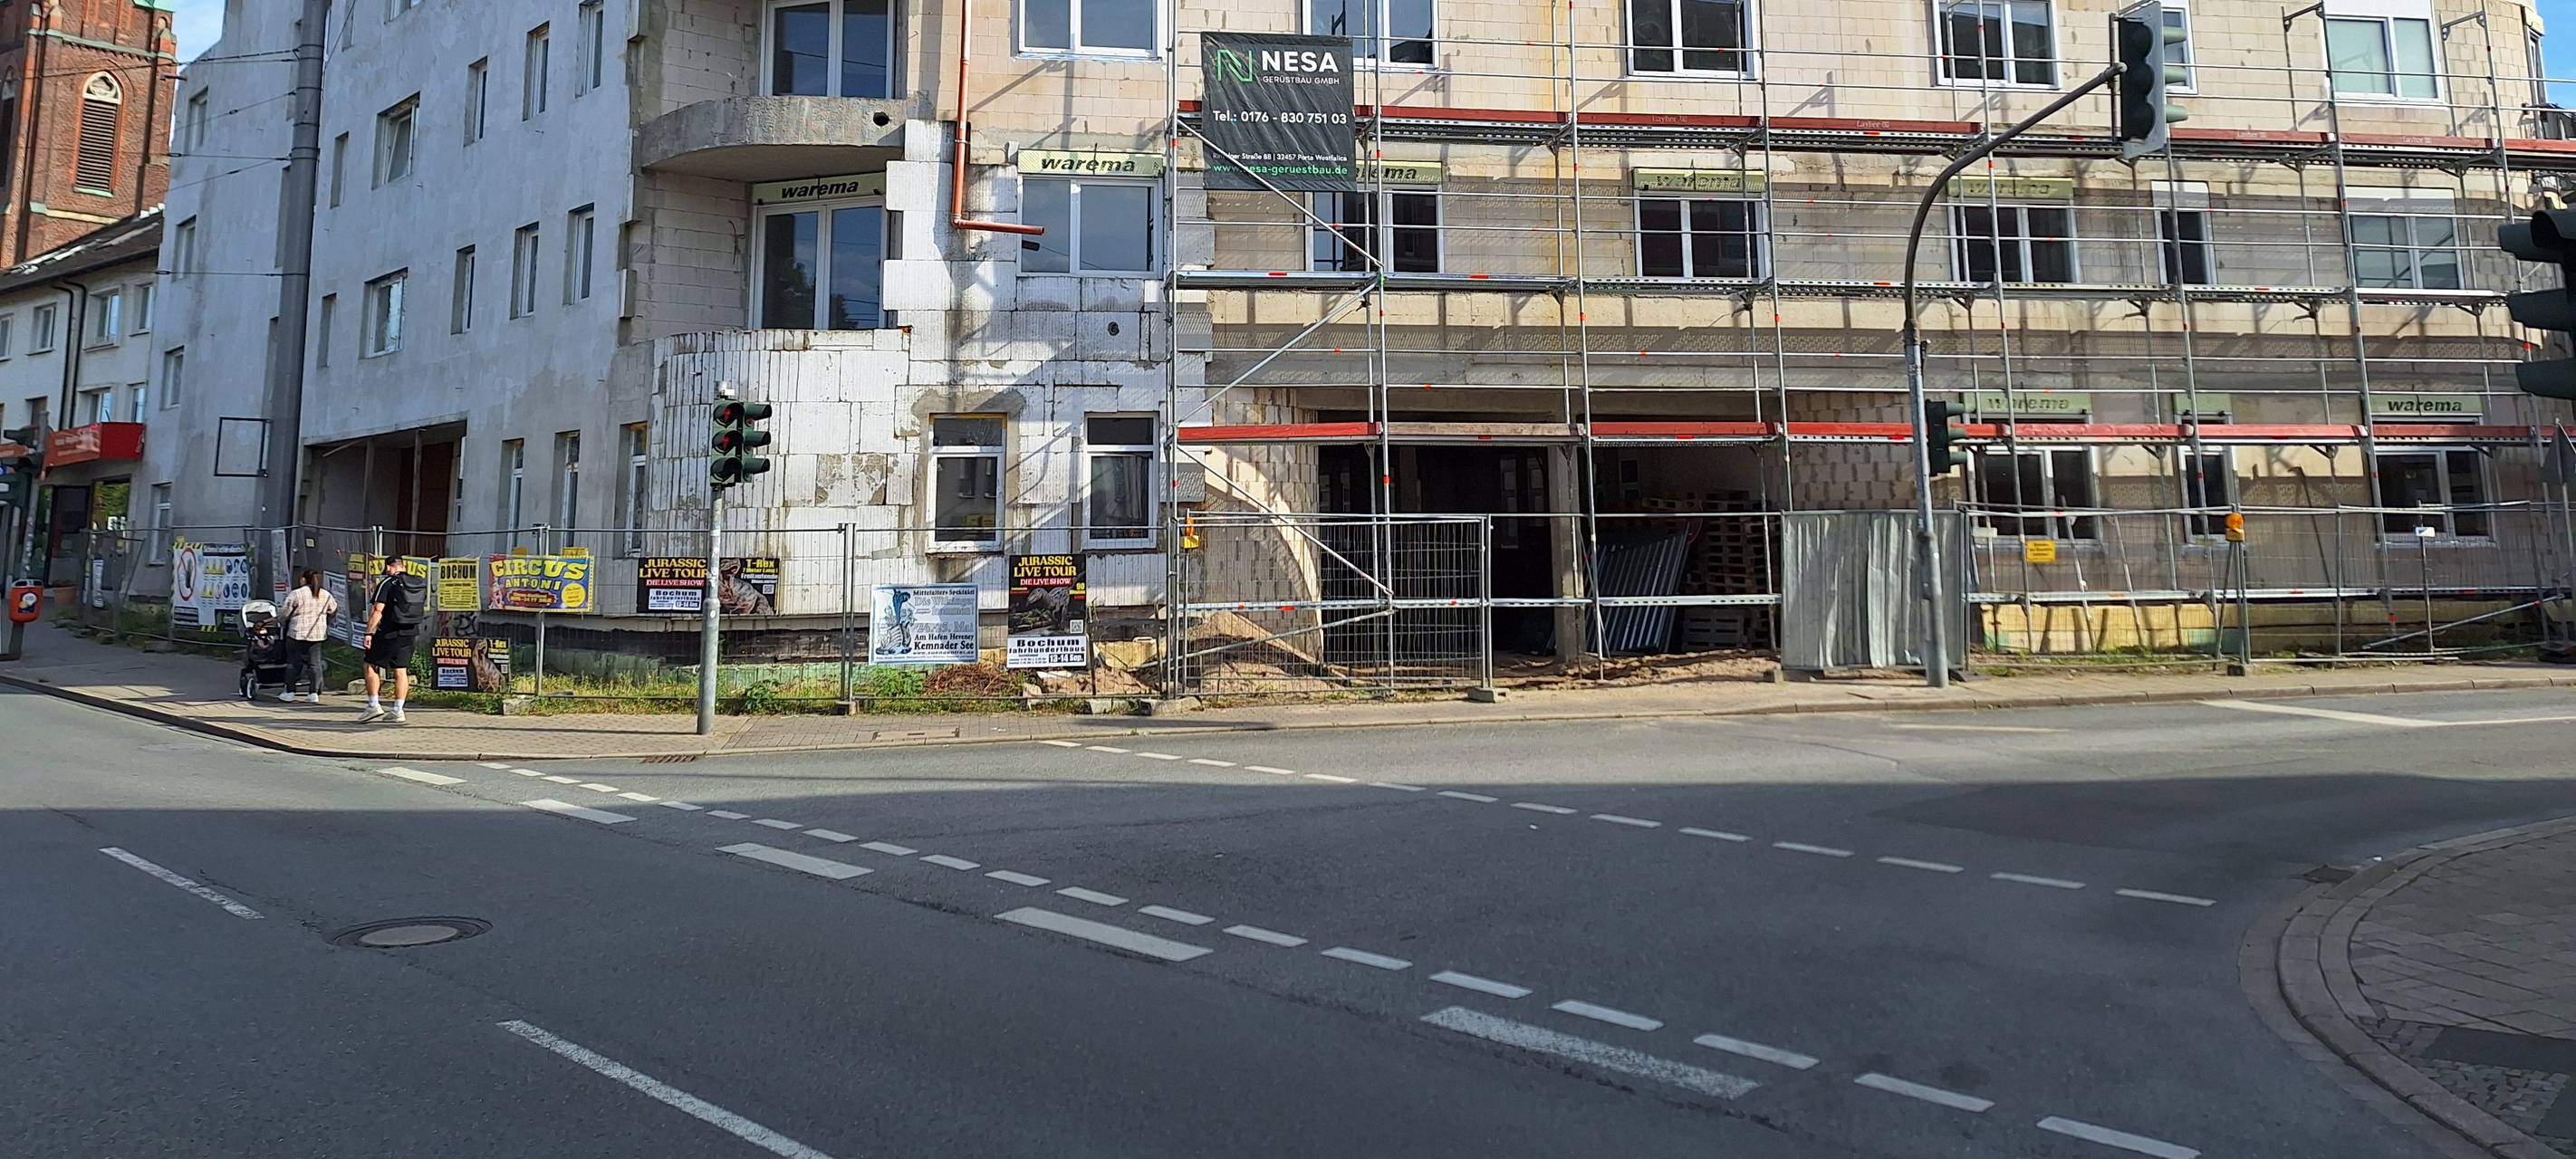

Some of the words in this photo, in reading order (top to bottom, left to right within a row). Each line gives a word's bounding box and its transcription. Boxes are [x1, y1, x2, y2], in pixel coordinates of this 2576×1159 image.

[1262, 50, 1339, 72] NESA
[1263, 75, 1312, 84] GERÜSTBAU
[1213, 110, 1237, 121] Tel.:
[1241, 110, 1269, 122] 0176
[1281, 112, 1304, 123] 830
[1308, 113, 1327, 124] 751
[1331, 113, 1347, 124] 03
[1042, 158, 1135, 171] warema
[782, 181, 859, 198] warema
[2389, 400, 2462, 411] warema
[645, 559, 706, 568] JURASSIC
[745, 559, 774, 568] T-Rex
[1018, 556, 1072, 566] JURASSIC
[440, 565, 476, 579] BOCHUM
[491, 559, 588, 580] CIRCUS
[639, 568, 670, 578] LIVE
[1014, 567, 1041, 577] LIVE
[1043, 566, 1077, 576] TOUR
[505, 578, 562, 590] ANTONI
[954, 621, 974, 633] Mai
[435, 638, 469, 647] JURASSIC
[914, 642, 957, 650] Kemnader
[960, 640, 974, 649] See
[432, 647, 449, 656] LIVE
[450, 647, 471, 657] TOUR
[1050, 655, 1068, 663] 13-14
